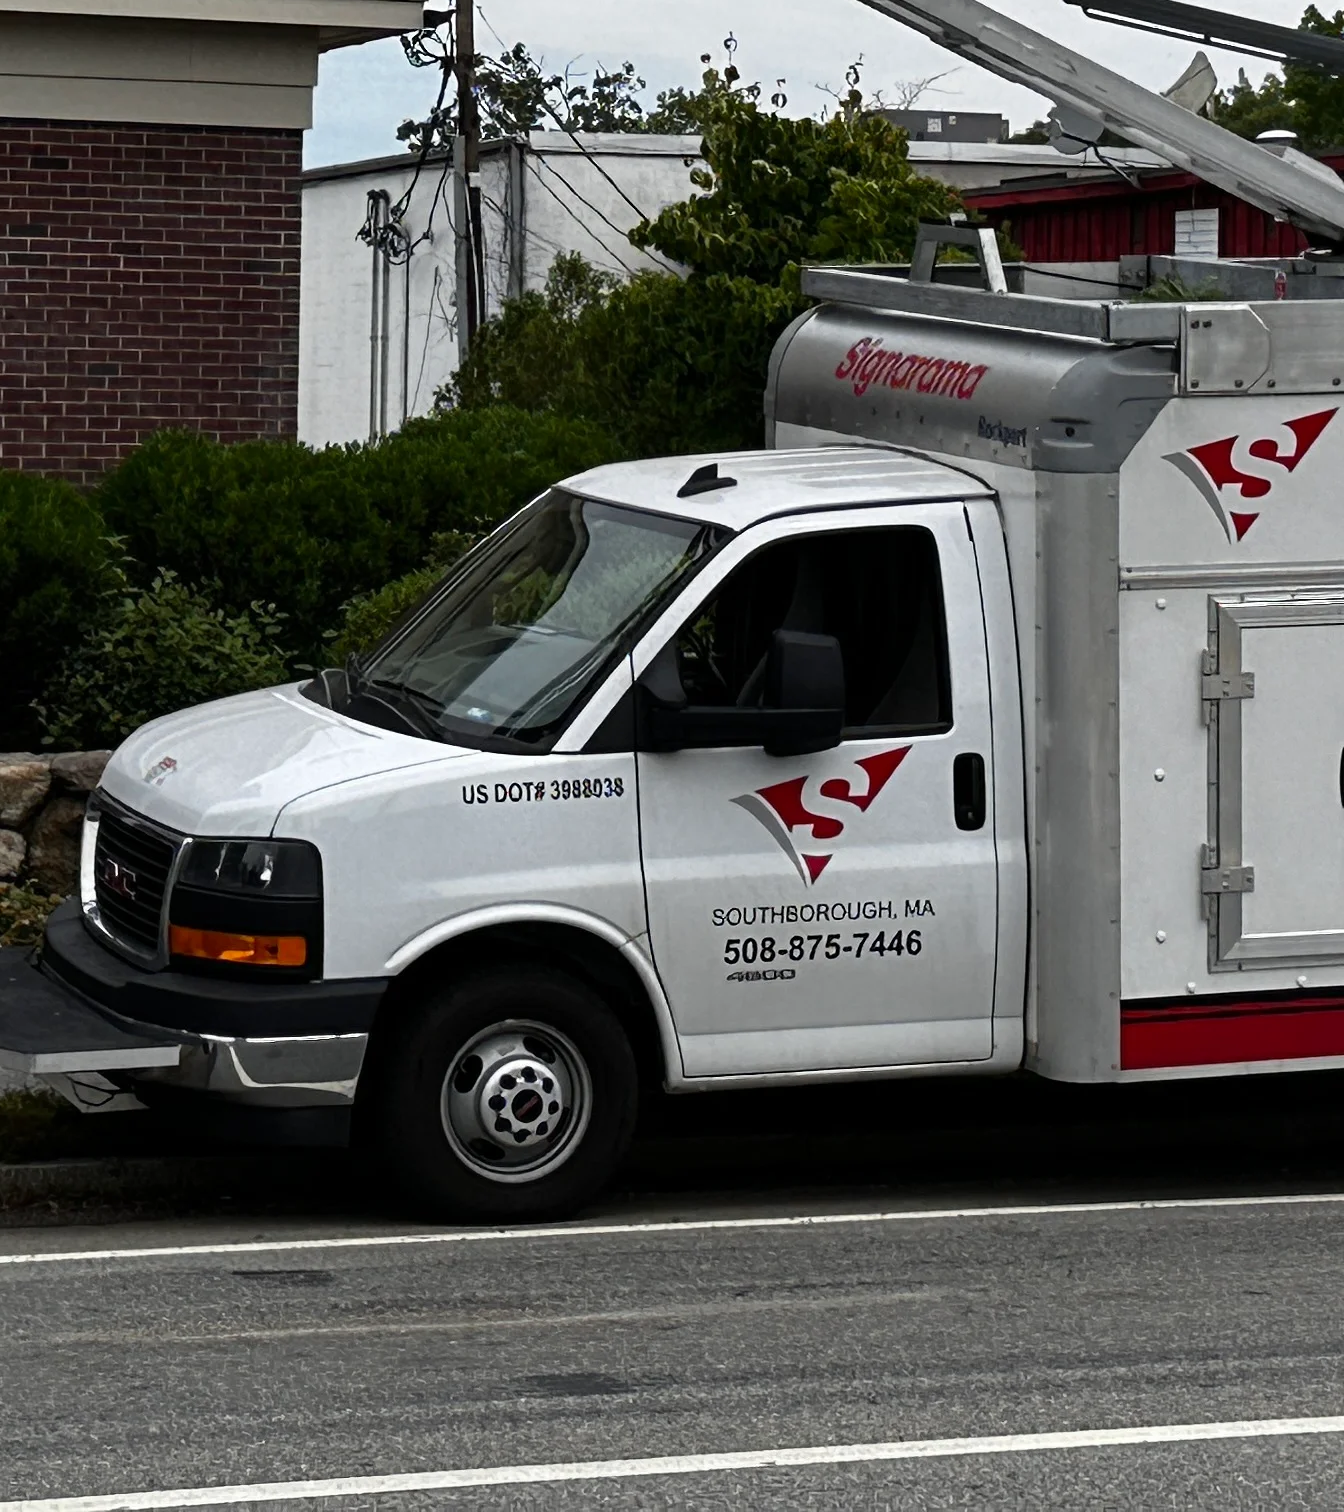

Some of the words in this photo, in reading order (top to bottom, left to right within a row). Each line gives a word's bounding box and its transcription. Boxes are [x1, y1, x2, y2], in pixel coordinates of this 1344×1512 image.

[834, 337, 990, 400] Signarama
[461, 784, 489, 805] US
[494, 781, 546, 803] DOT#
[711, 901, 898, 927] SOUTHBOROUGH,
[904, 899, 936, 918] MA
[723, 929, 923, 965] 508-875-7446
